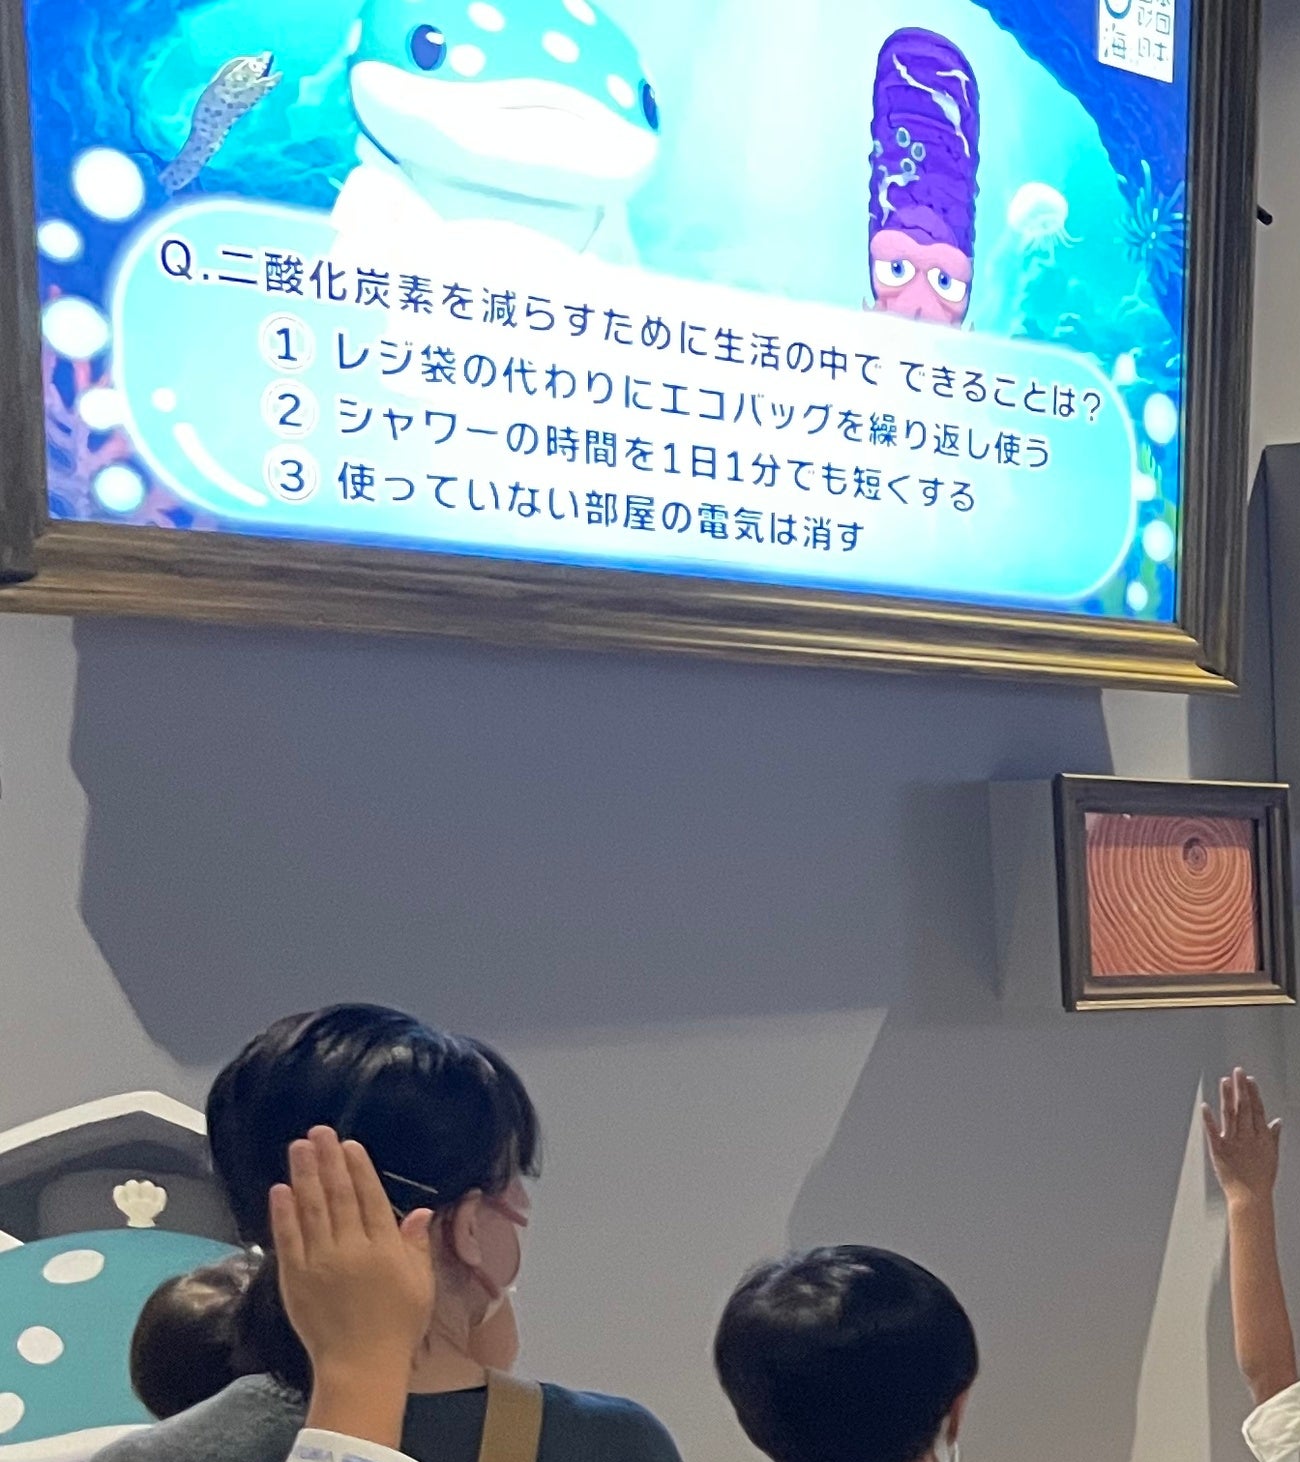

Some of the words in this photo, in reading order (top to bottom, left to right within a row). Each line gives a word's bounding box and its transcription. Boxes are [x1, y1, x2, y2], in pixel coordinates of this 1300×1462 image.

[337, 332, 1050, 467] レジ袋の代わりにエコバッグを繰り返し使う
[338, 397, 976, 512] シャワーの時間を1日1分でも短くする
[338, 461, 865, 552] 使っていない部屋の電気は消す
